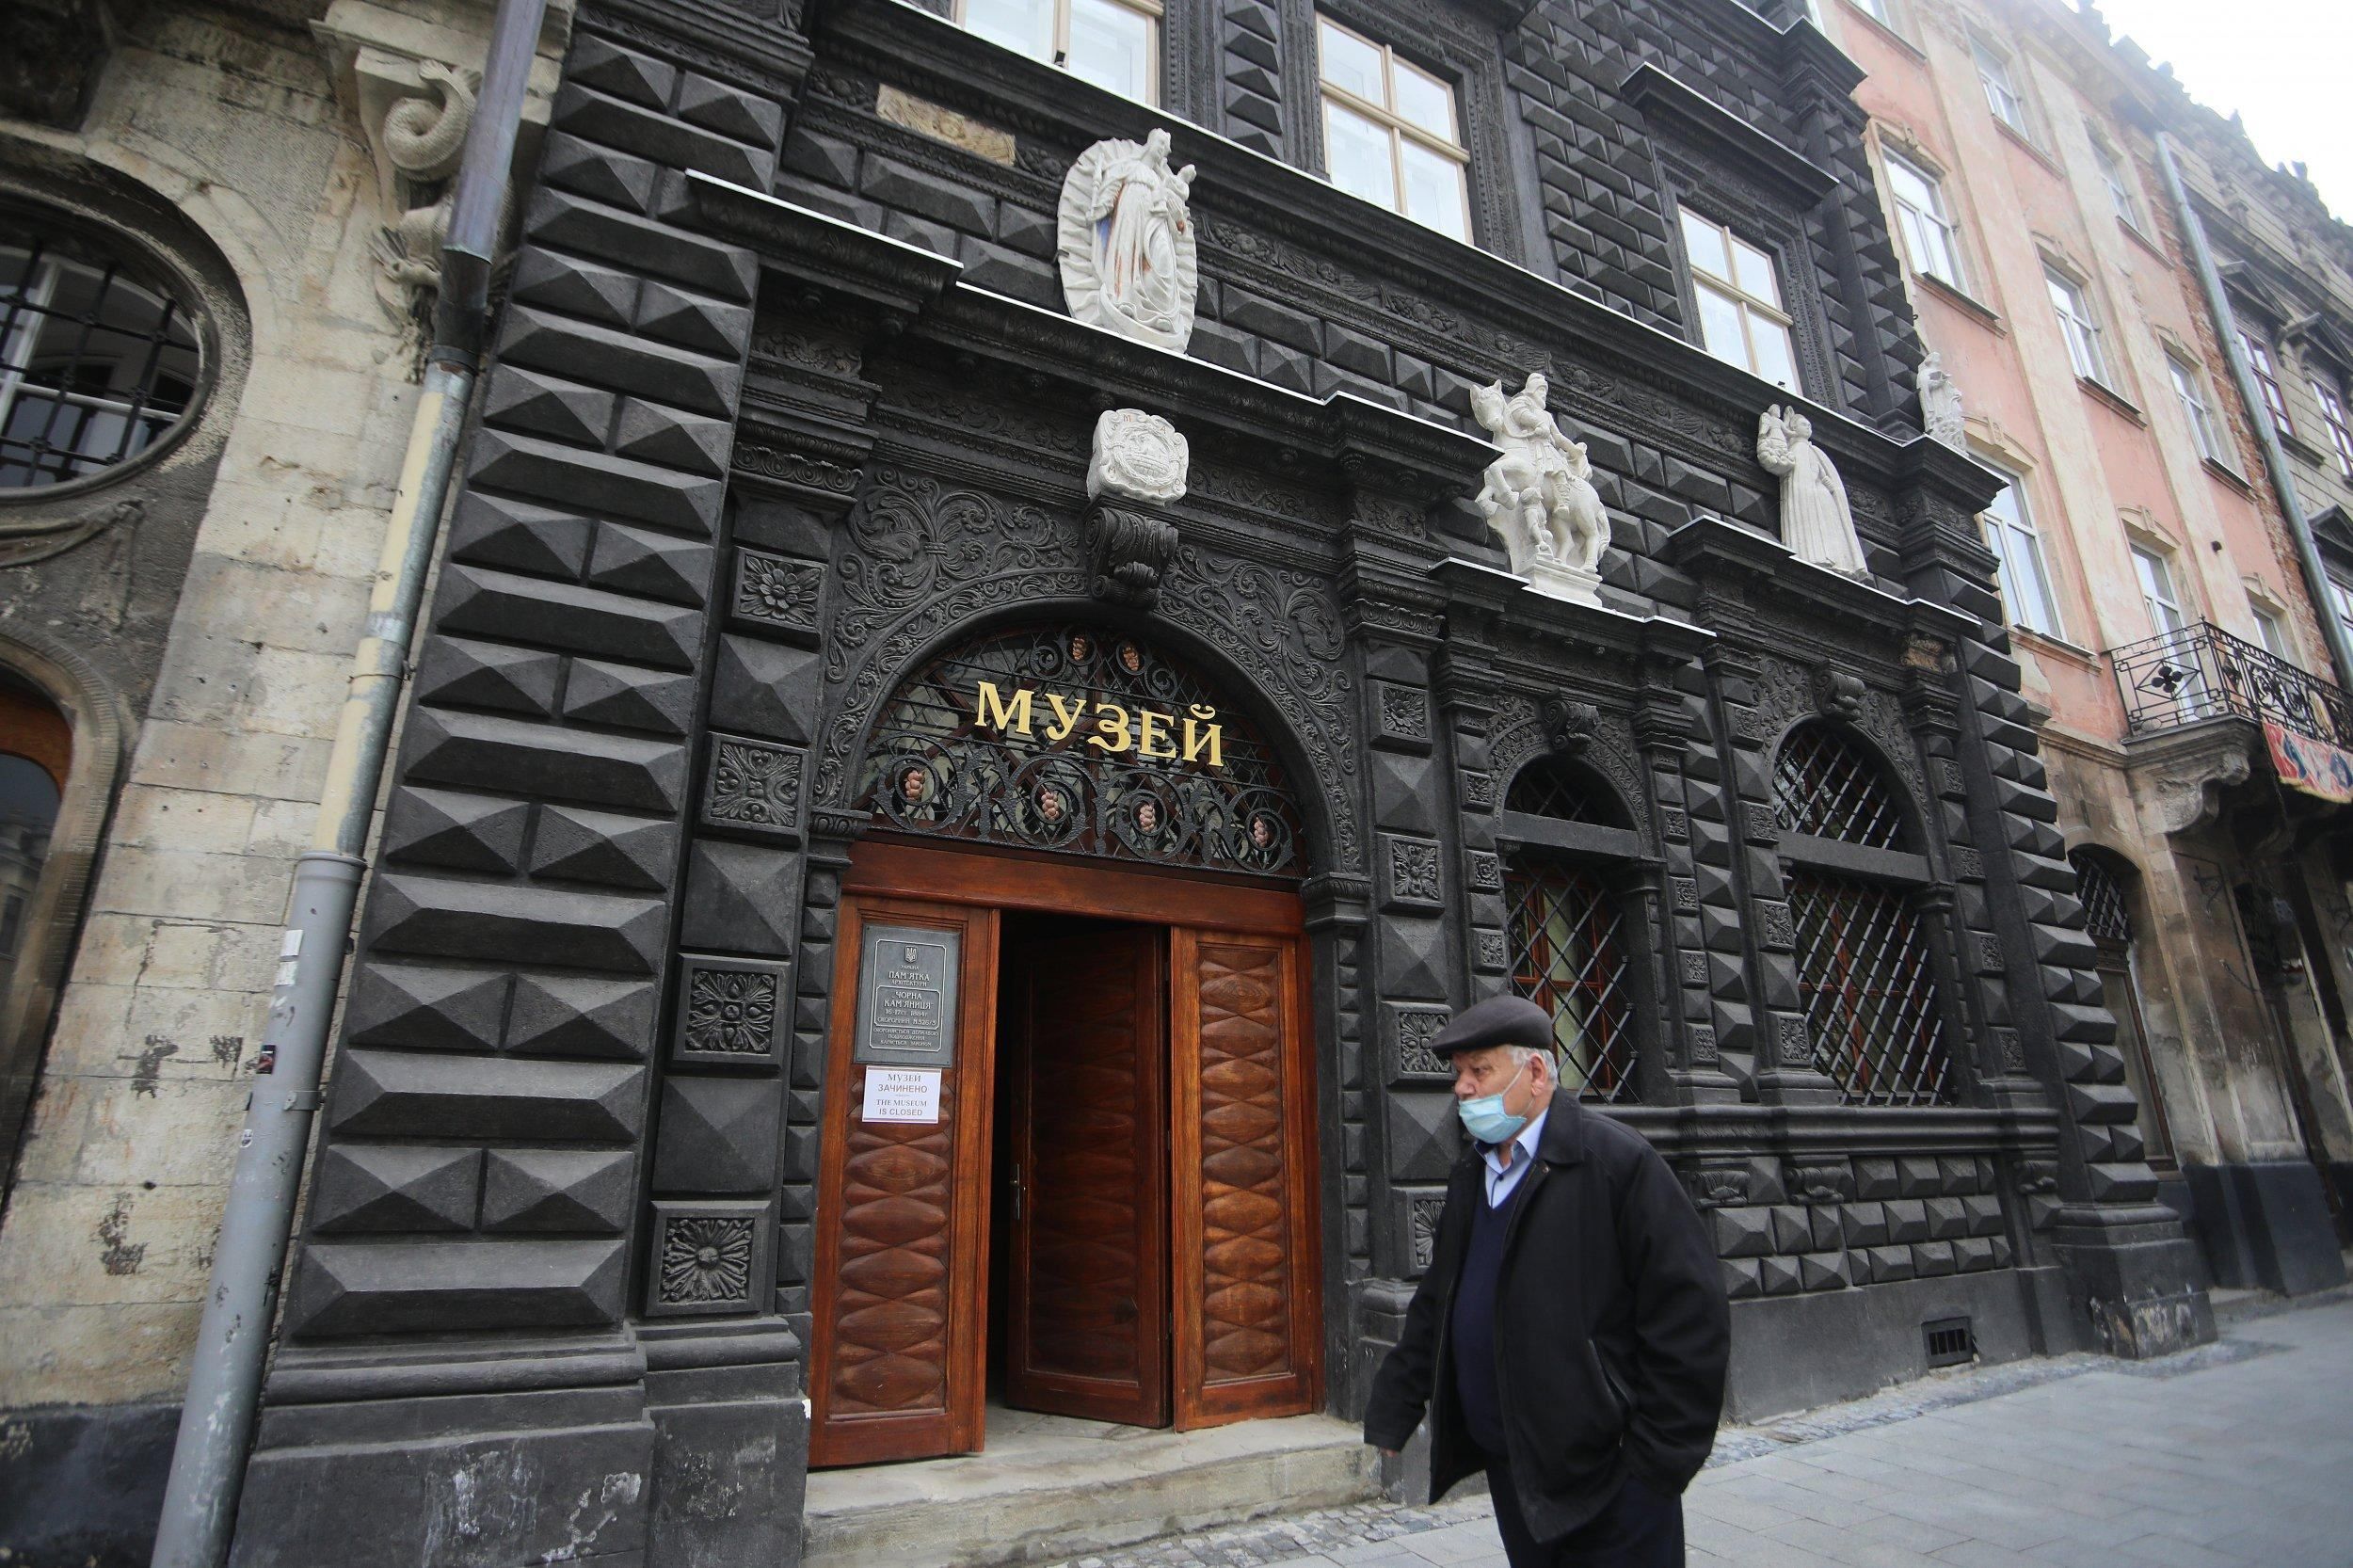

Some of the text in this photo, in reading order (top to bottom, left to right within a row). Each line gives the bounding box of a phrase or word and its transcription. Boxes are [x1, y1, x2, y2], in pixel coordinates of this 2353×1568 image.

[974, 680, 1224, 767] МУЗЕЙ
[888, 1072, 921, 1083] МУЗЕЙ
[878, 1083, 928, 1094] ЗАЧИНЕНО
[889, 1108, 923, 1116] CLOSED
